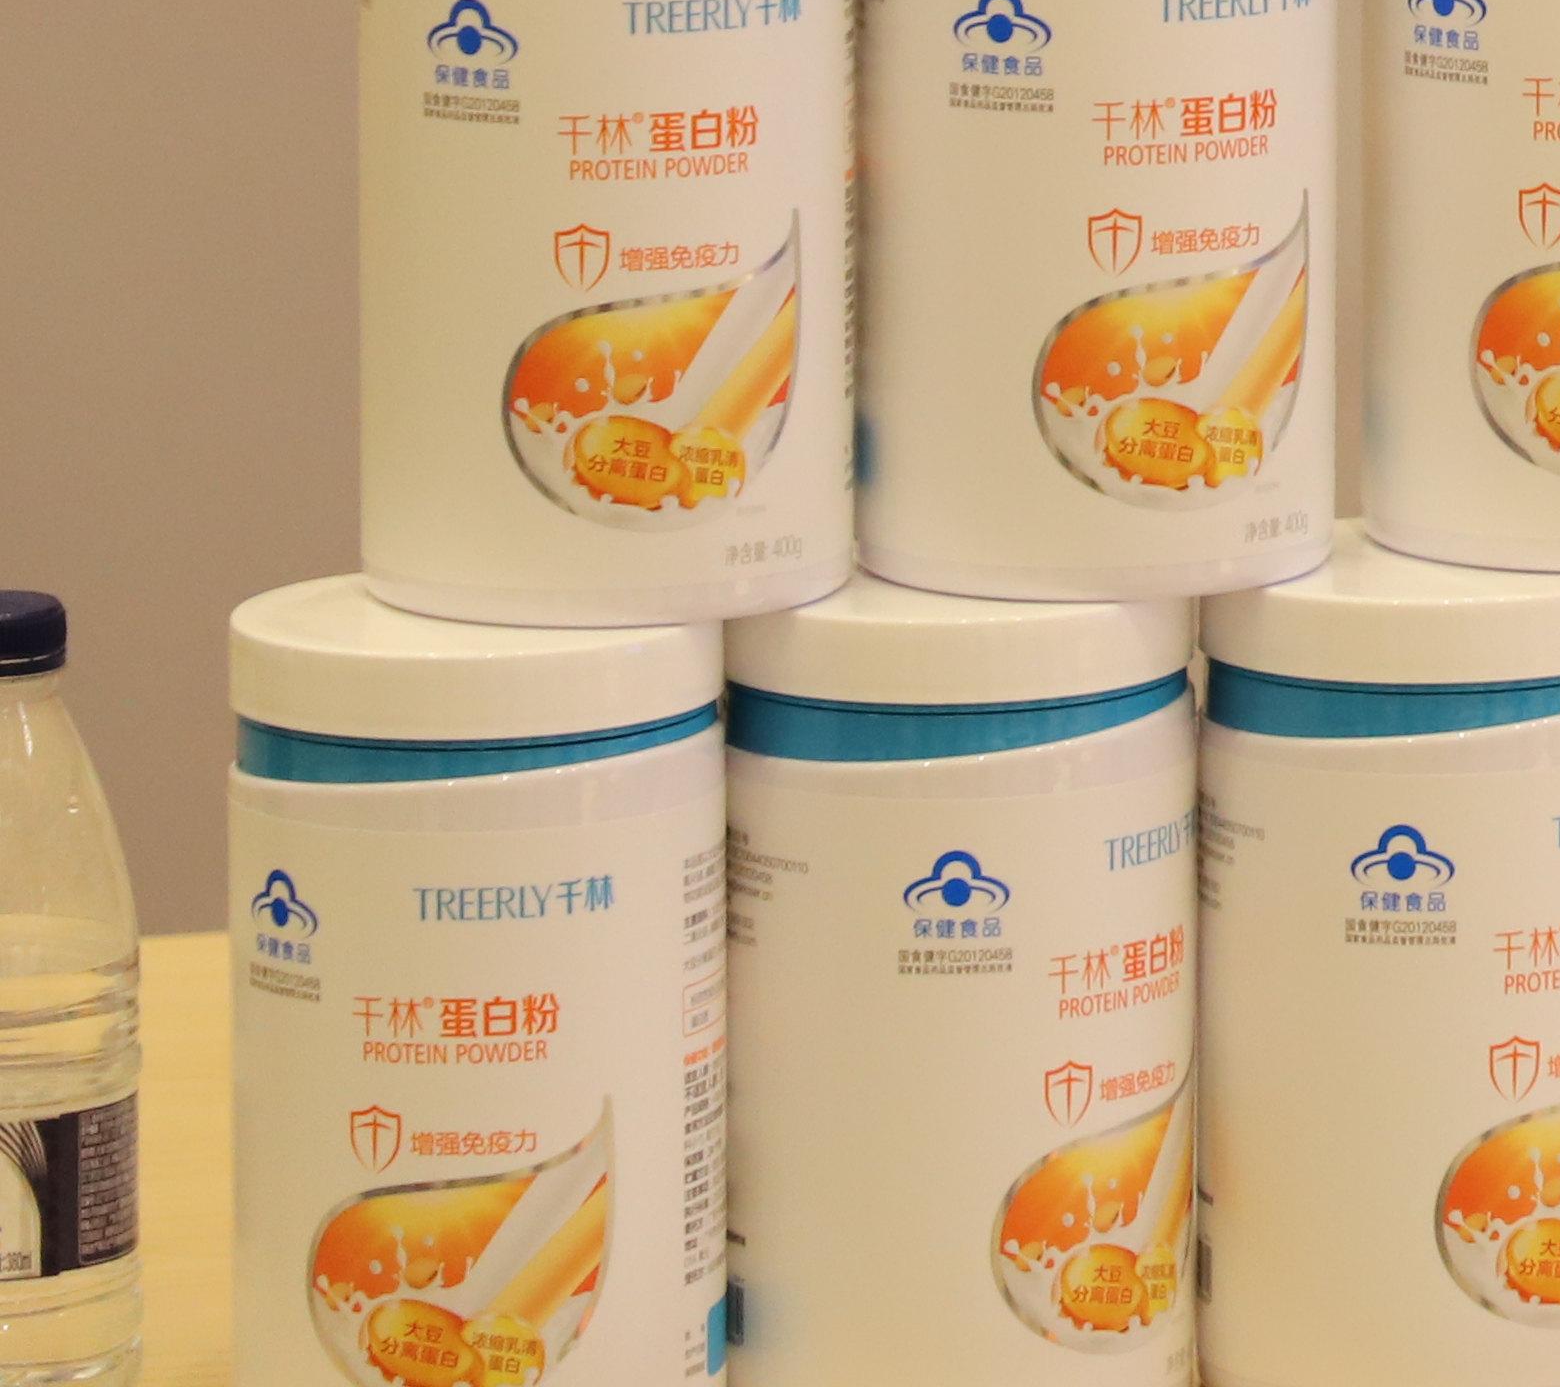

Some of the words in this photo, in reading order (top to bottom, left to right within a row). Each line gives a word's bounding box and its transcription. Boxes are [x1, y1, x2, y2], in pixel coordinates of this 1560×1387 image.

[1414, 23, 1479, 51] 保健食品
[434, 64, 511, 90] 保健食品
[961, 52, 1043, 77] 保健食品
[1103, 141, 1188, 167] PROTEIN
[1194, 134, 1270, 162] POWDER
[568, 158, 657, 181] PROTEIN
[664, 152, 748, 179] POWDER
[1151, 226, 1260, 257] 增强免疫力
[619, 242, 740, 274] 增强免疫力
[1142, 418, 1182, 439] 大豆
[613, 437, 652, 459] 大豆
[1118, 436, 1194, 463] 分离蛋白
[586, 453, 668, 483] 分离蛋白
[1360, 890, 1447, 912] 保健食品
[913, 916, 1003, 939] 保健食品
[1058, 988, 1129, 1020] PROTEIN
[1132, 971, 1181, 1008] POWDER
[362, 1042, 448, 1065] PROTEIN
[455, 1041, 548, 1064] POWDER
[1099, 1062, 1177, 1102] 增强免疫力
[411, 1130, 538, 1158] 增强免疫力
[1091, 1265, 1122, 1283] 大豆
[1071, 1285, 1133, 1305] 分离蛋白
[404, 1320, 444, 1344] 大豆
[378, 1336, 460, 1368] 分离蛋白
